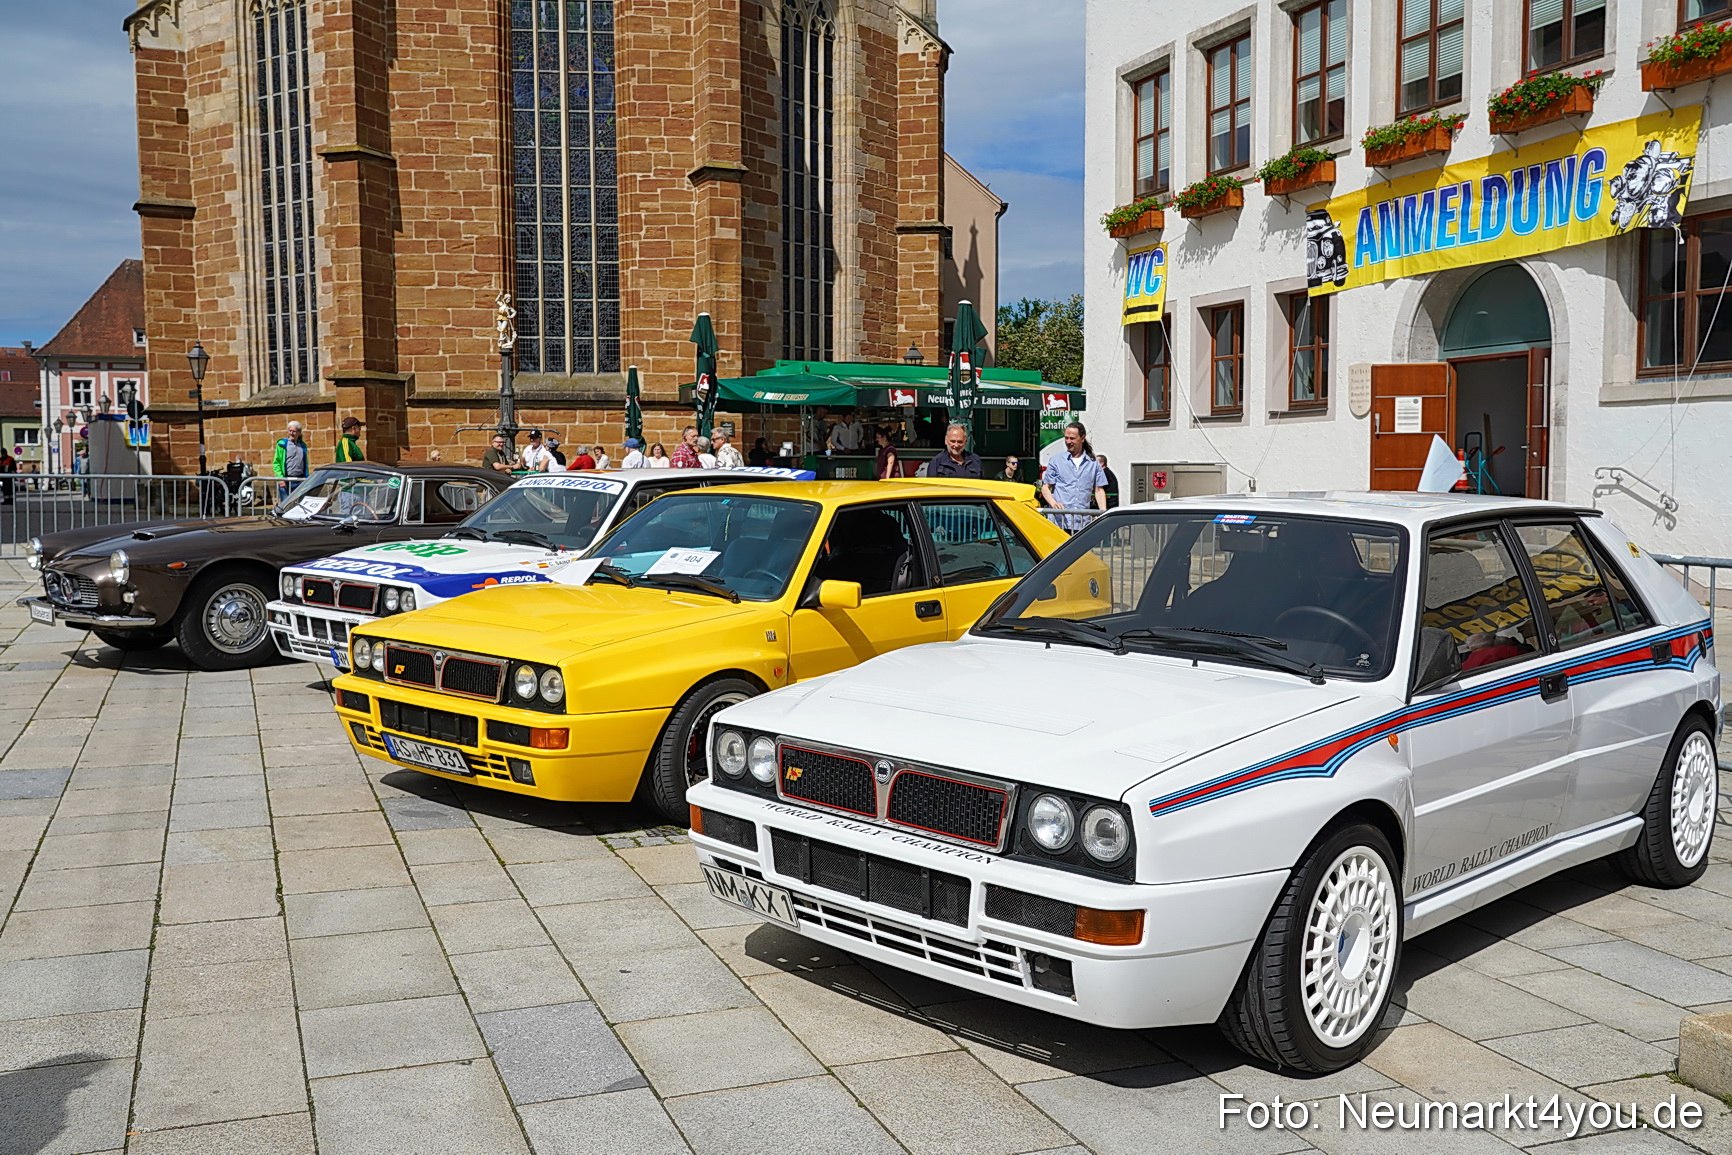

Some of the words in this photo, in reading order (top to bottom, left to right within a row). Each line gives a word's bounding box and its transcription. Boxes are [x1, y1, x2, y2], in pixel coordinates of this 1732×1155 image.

[1353, 147, 1607, 268] ANMELDUNG
[1126, 247, 1164, 299] WC
[981, 395, 1030, 406] Lammsbräu
[519, 478, 556, 486] LANCIA
[556, 478, 615, 490] REPSOL
[303, 557, 413, 579] REPSOL
[684, 554, 703, 564] 404
[501, 574, 536, 584] REPSOL
[393, 738, 411, 758] AS
[414, 743, 435, 763] HF
[435, 748, 467, 770] 831
[764, 803, 823, 821] WORLD
[825, 818, 889, 837] RALLY
[891, 834, 999, 866] CHAMPION
[1412, 862, 1456, 893] WORLD
[1459, 845, 1498, 874] RALLY
[1499, 823, 1552, 857] CHAMPION
